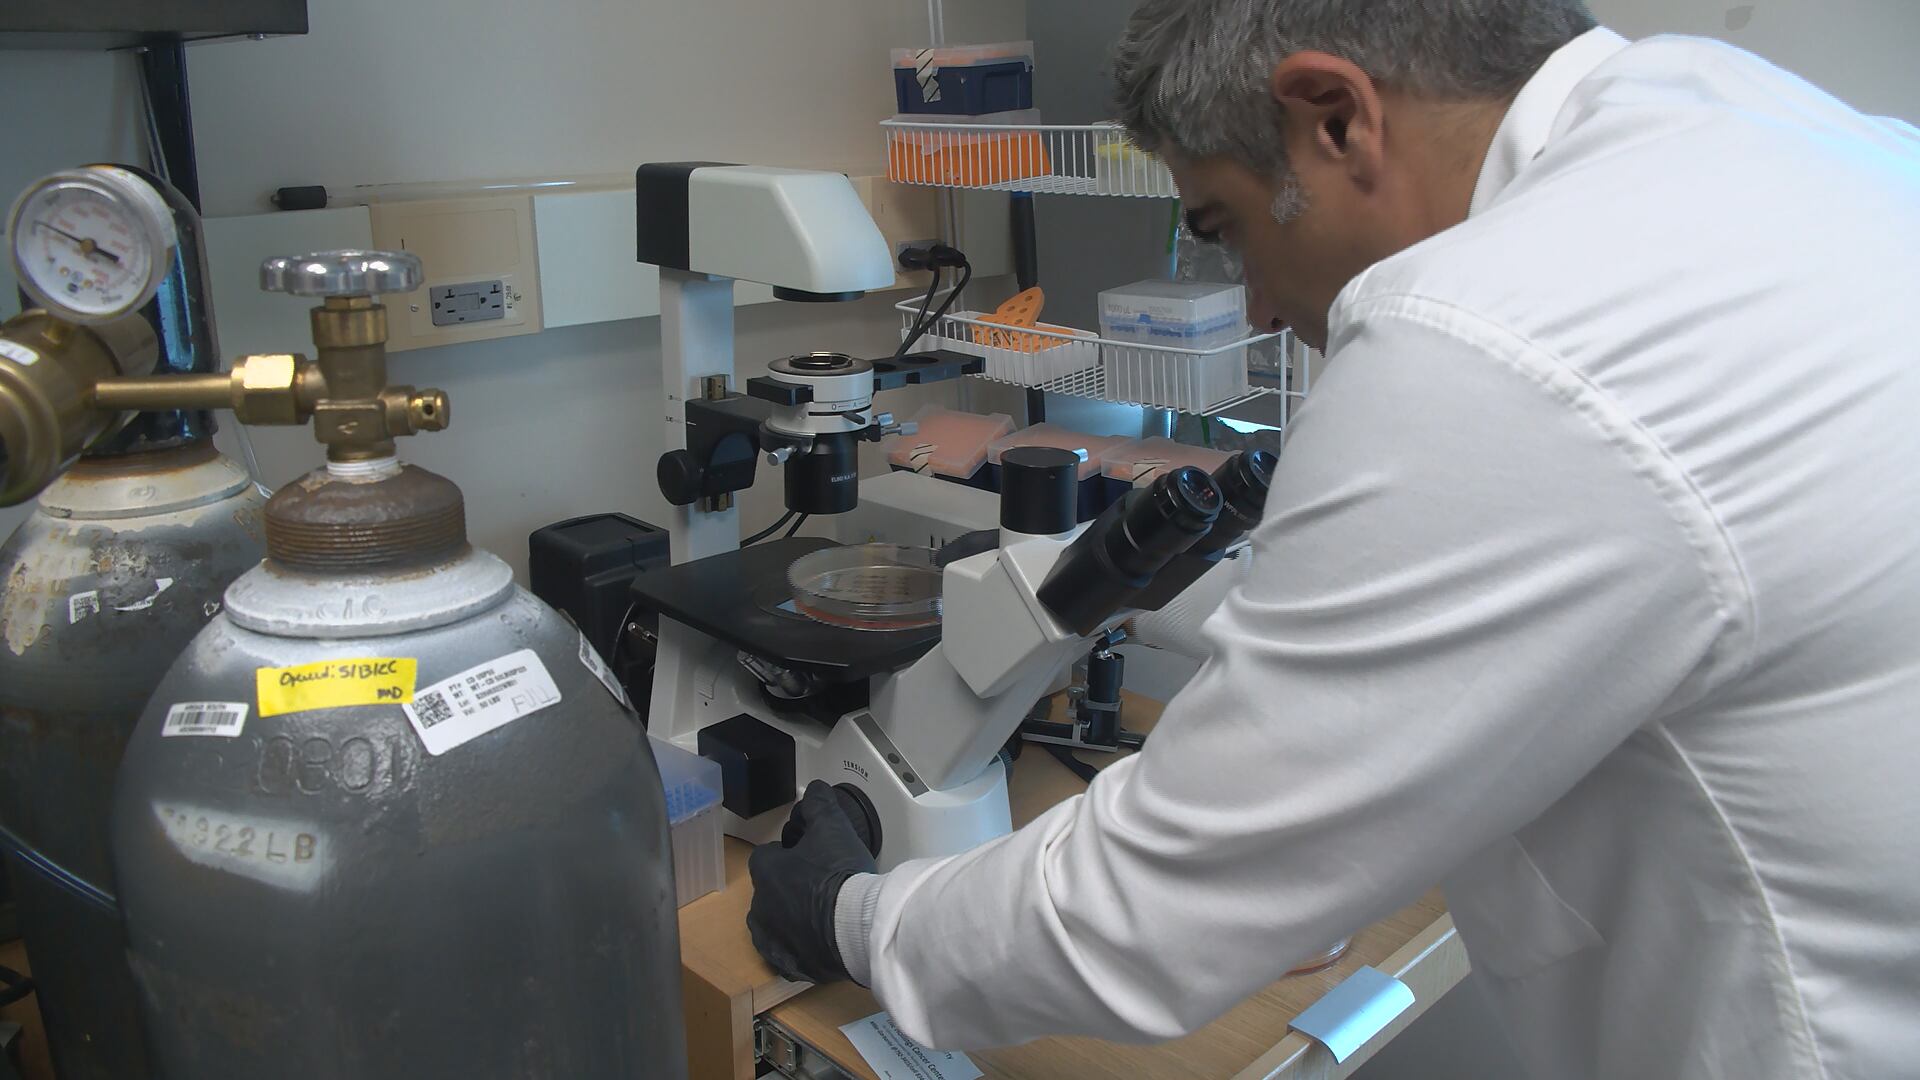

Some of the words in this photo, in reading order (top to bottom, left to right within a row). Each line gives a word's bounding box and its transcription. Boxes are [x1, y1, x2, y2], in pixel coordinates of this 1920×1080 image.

[843, 760, 869, 778] TENSION
[912, 1047, 931, 1066] Cancer
[928, 1063, 946, 1080] Cente
